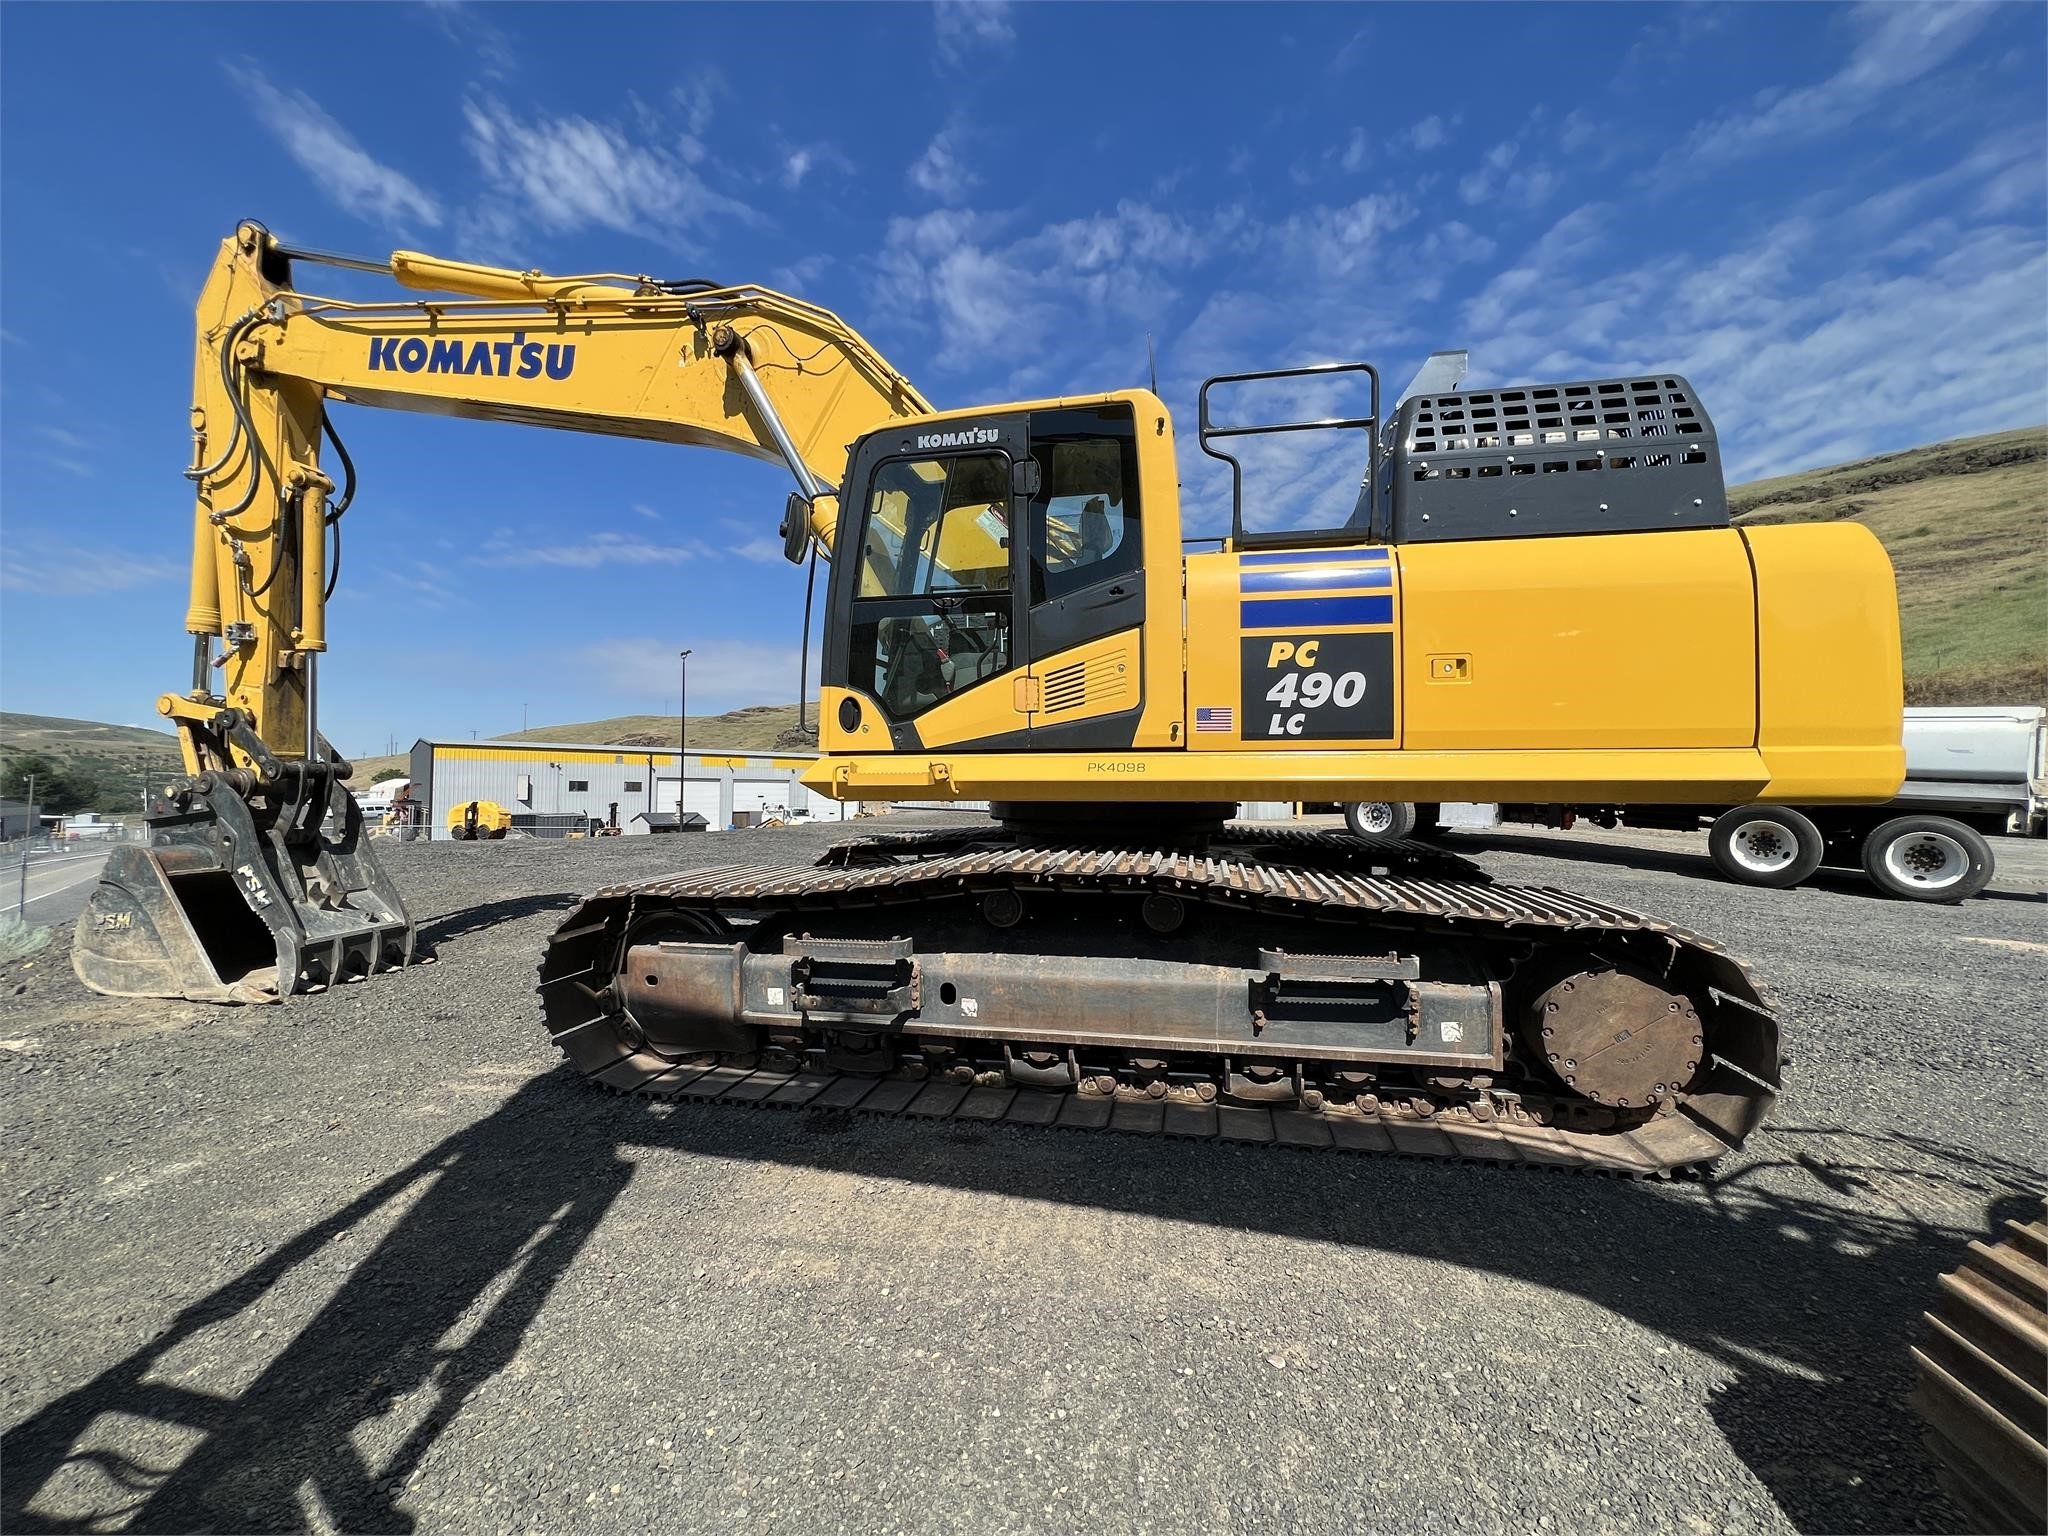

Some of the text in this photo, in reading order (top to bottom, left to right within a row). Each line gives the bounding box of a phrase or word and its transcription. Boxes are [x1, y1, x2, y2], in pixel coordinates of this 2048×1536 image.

[369, 332, 576, 380] KOMATSU
[918, 427, 998, 448] KOMATSU
[1267, 641, 1319, 668] PC
[1266, 671, 1366, 708] 490
[1268, 713, 1306, 735] LC
[1087, 762, 1146, 773] PK4098
